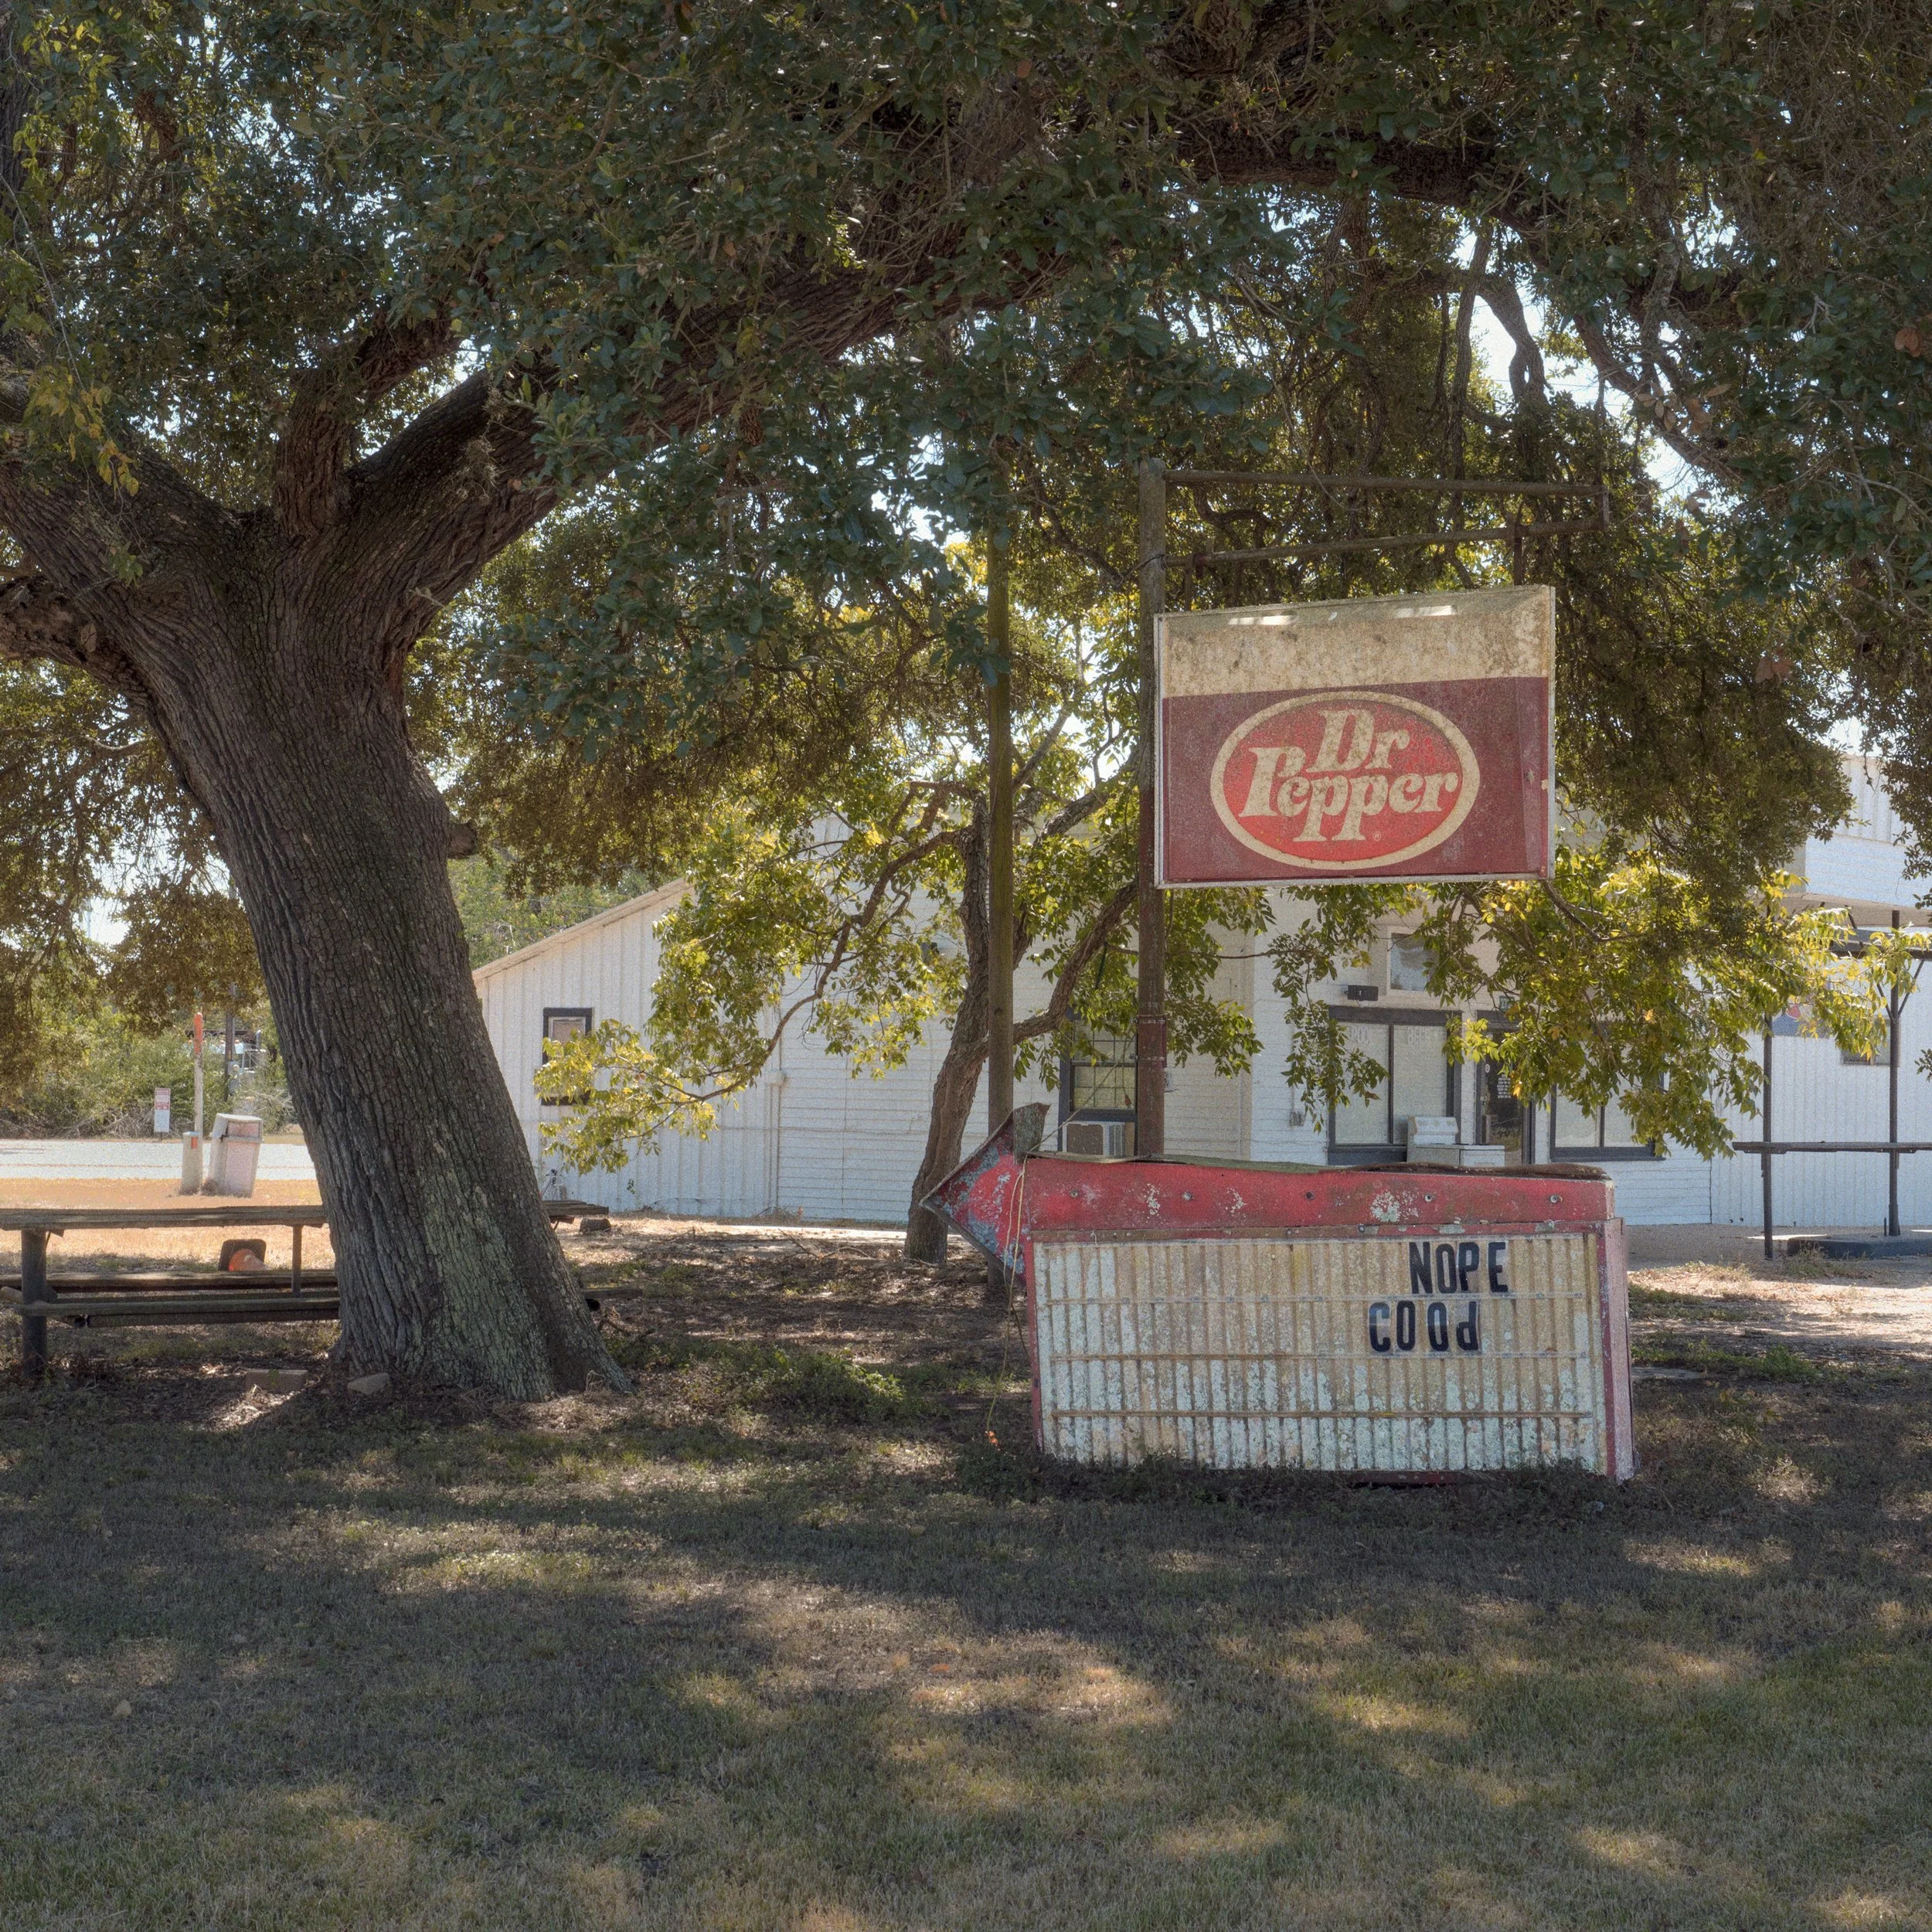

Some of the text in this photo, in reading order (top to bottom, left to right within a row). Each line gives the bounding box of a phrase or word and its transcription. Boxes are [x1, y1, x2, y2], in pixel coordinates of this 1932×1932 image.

[1306, 709, 1410, 773] Dr
[1238, 747, 1459, 842] Pepper
[1409, 1241, 1509, 1294] NOPE
